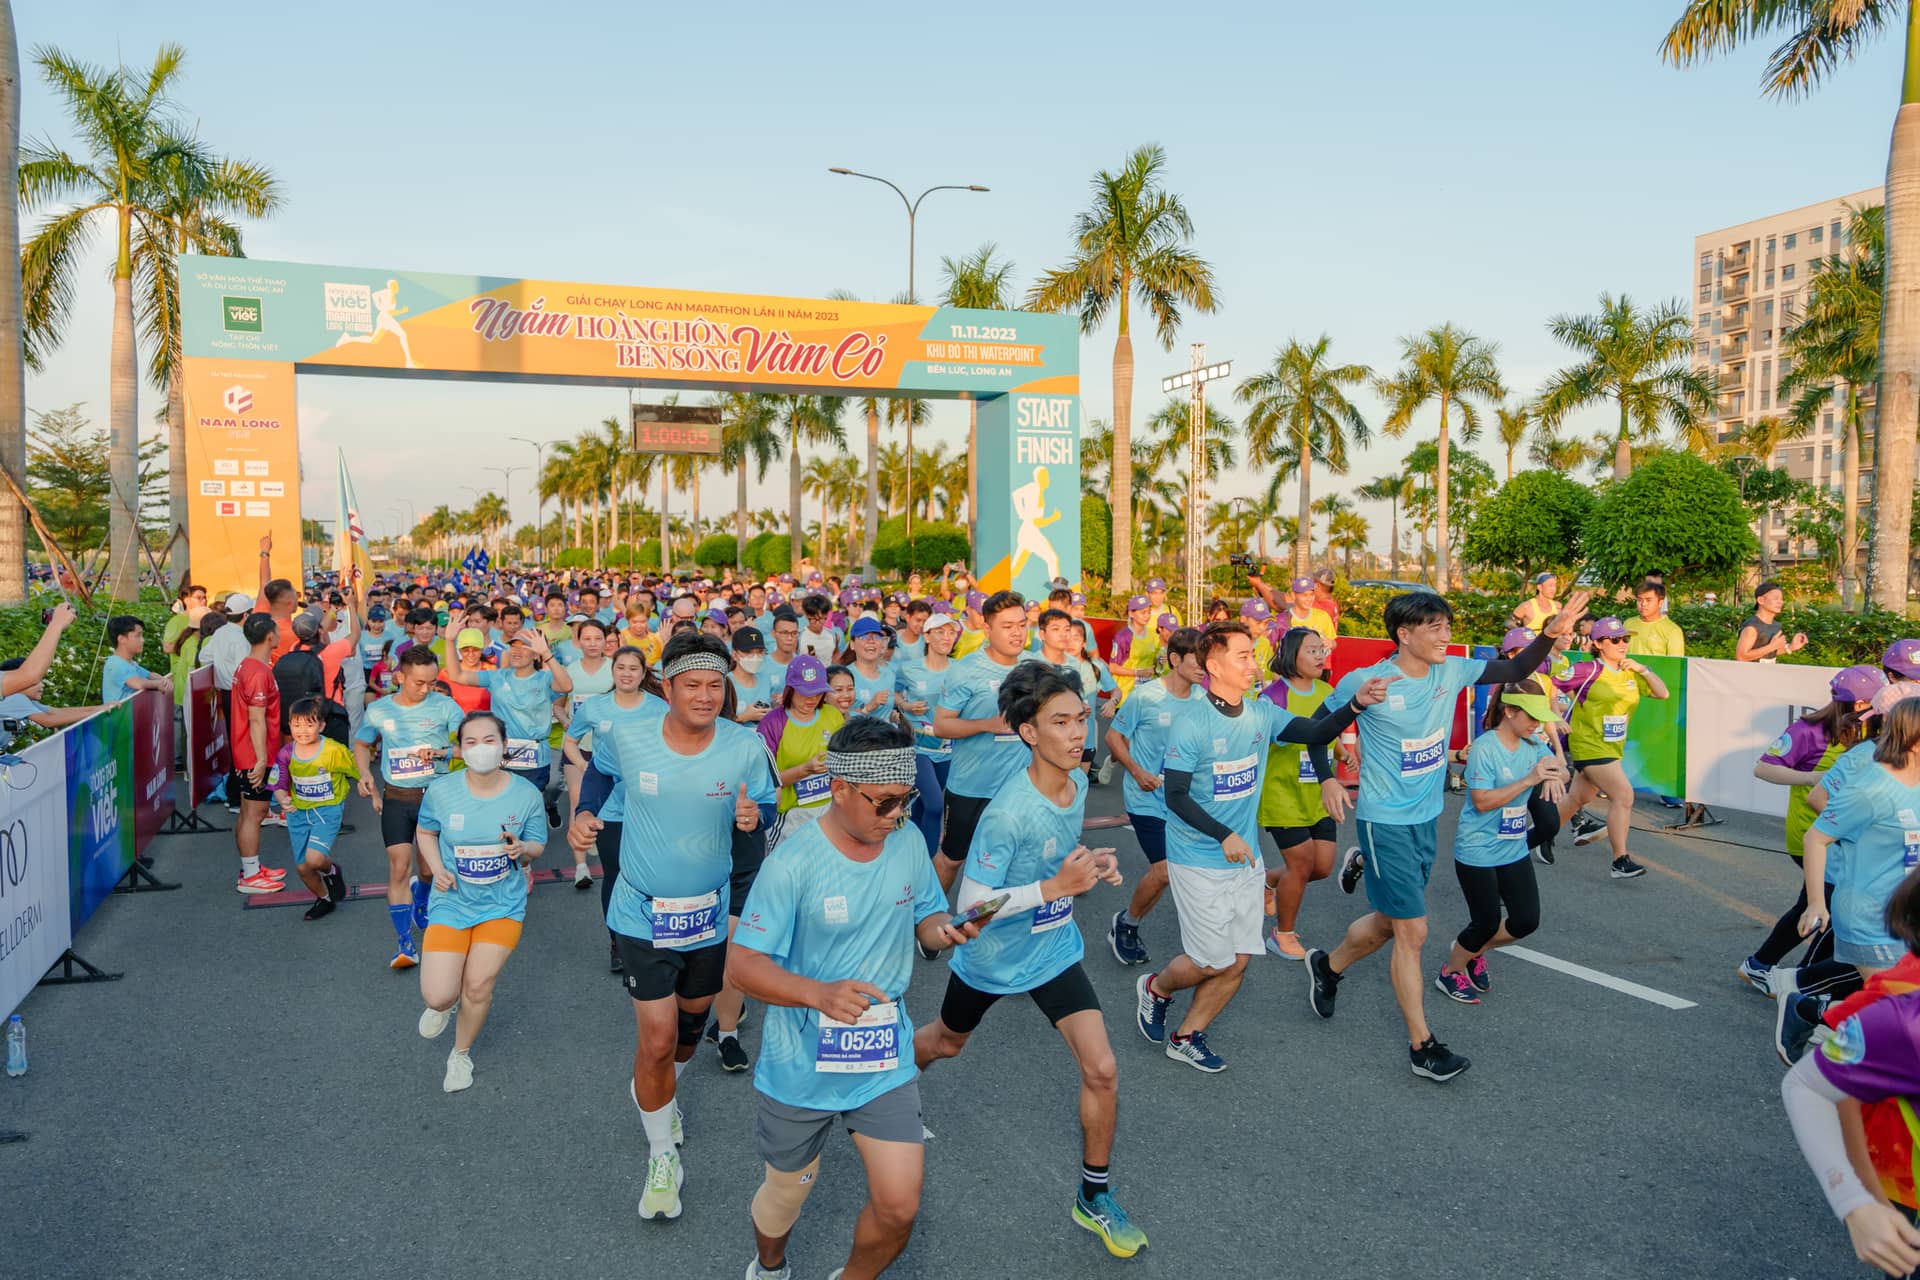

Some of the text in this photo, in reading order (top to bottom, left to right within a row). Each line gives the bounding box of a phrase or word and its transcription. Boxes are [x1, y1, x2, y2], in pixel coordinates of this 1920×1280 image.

[471, 297, 571, 341] Ngắm
[630, 299, 662, 310] LONG
[666, 302, 683, 311] AN
[686, 303, 751, 315] MARATHON
[815, 312, 840, 321] 2023
[951, 325, 1016, 341] 11.11.2023
[672, 344, 739, 372] SÔNG
[731, 326, 887, 379] Vàm Cỏ
[926, 343, 946, 358] KHU
[980, 346, 1035, 362] WATERPOINT
[971, 367, 996, 376] LONG
[998, 368, 1012, 377] AN
[1016, 397, 1072, 427] START
[200, 418, 281, 429] NAM LONG
[1017, 436, 1073, 464] FINISH
[1415, 743, 1443, 764] 05383
[1228, 768, 1255, 788] 05381
[469, 856, 508, 872] 05238
[656, 913, 663, 921] 5
[669, 909, 712, 931] 05137
[825, 1028, 833, 1038] 5
[840, 1027, 894, 1052] 05239
